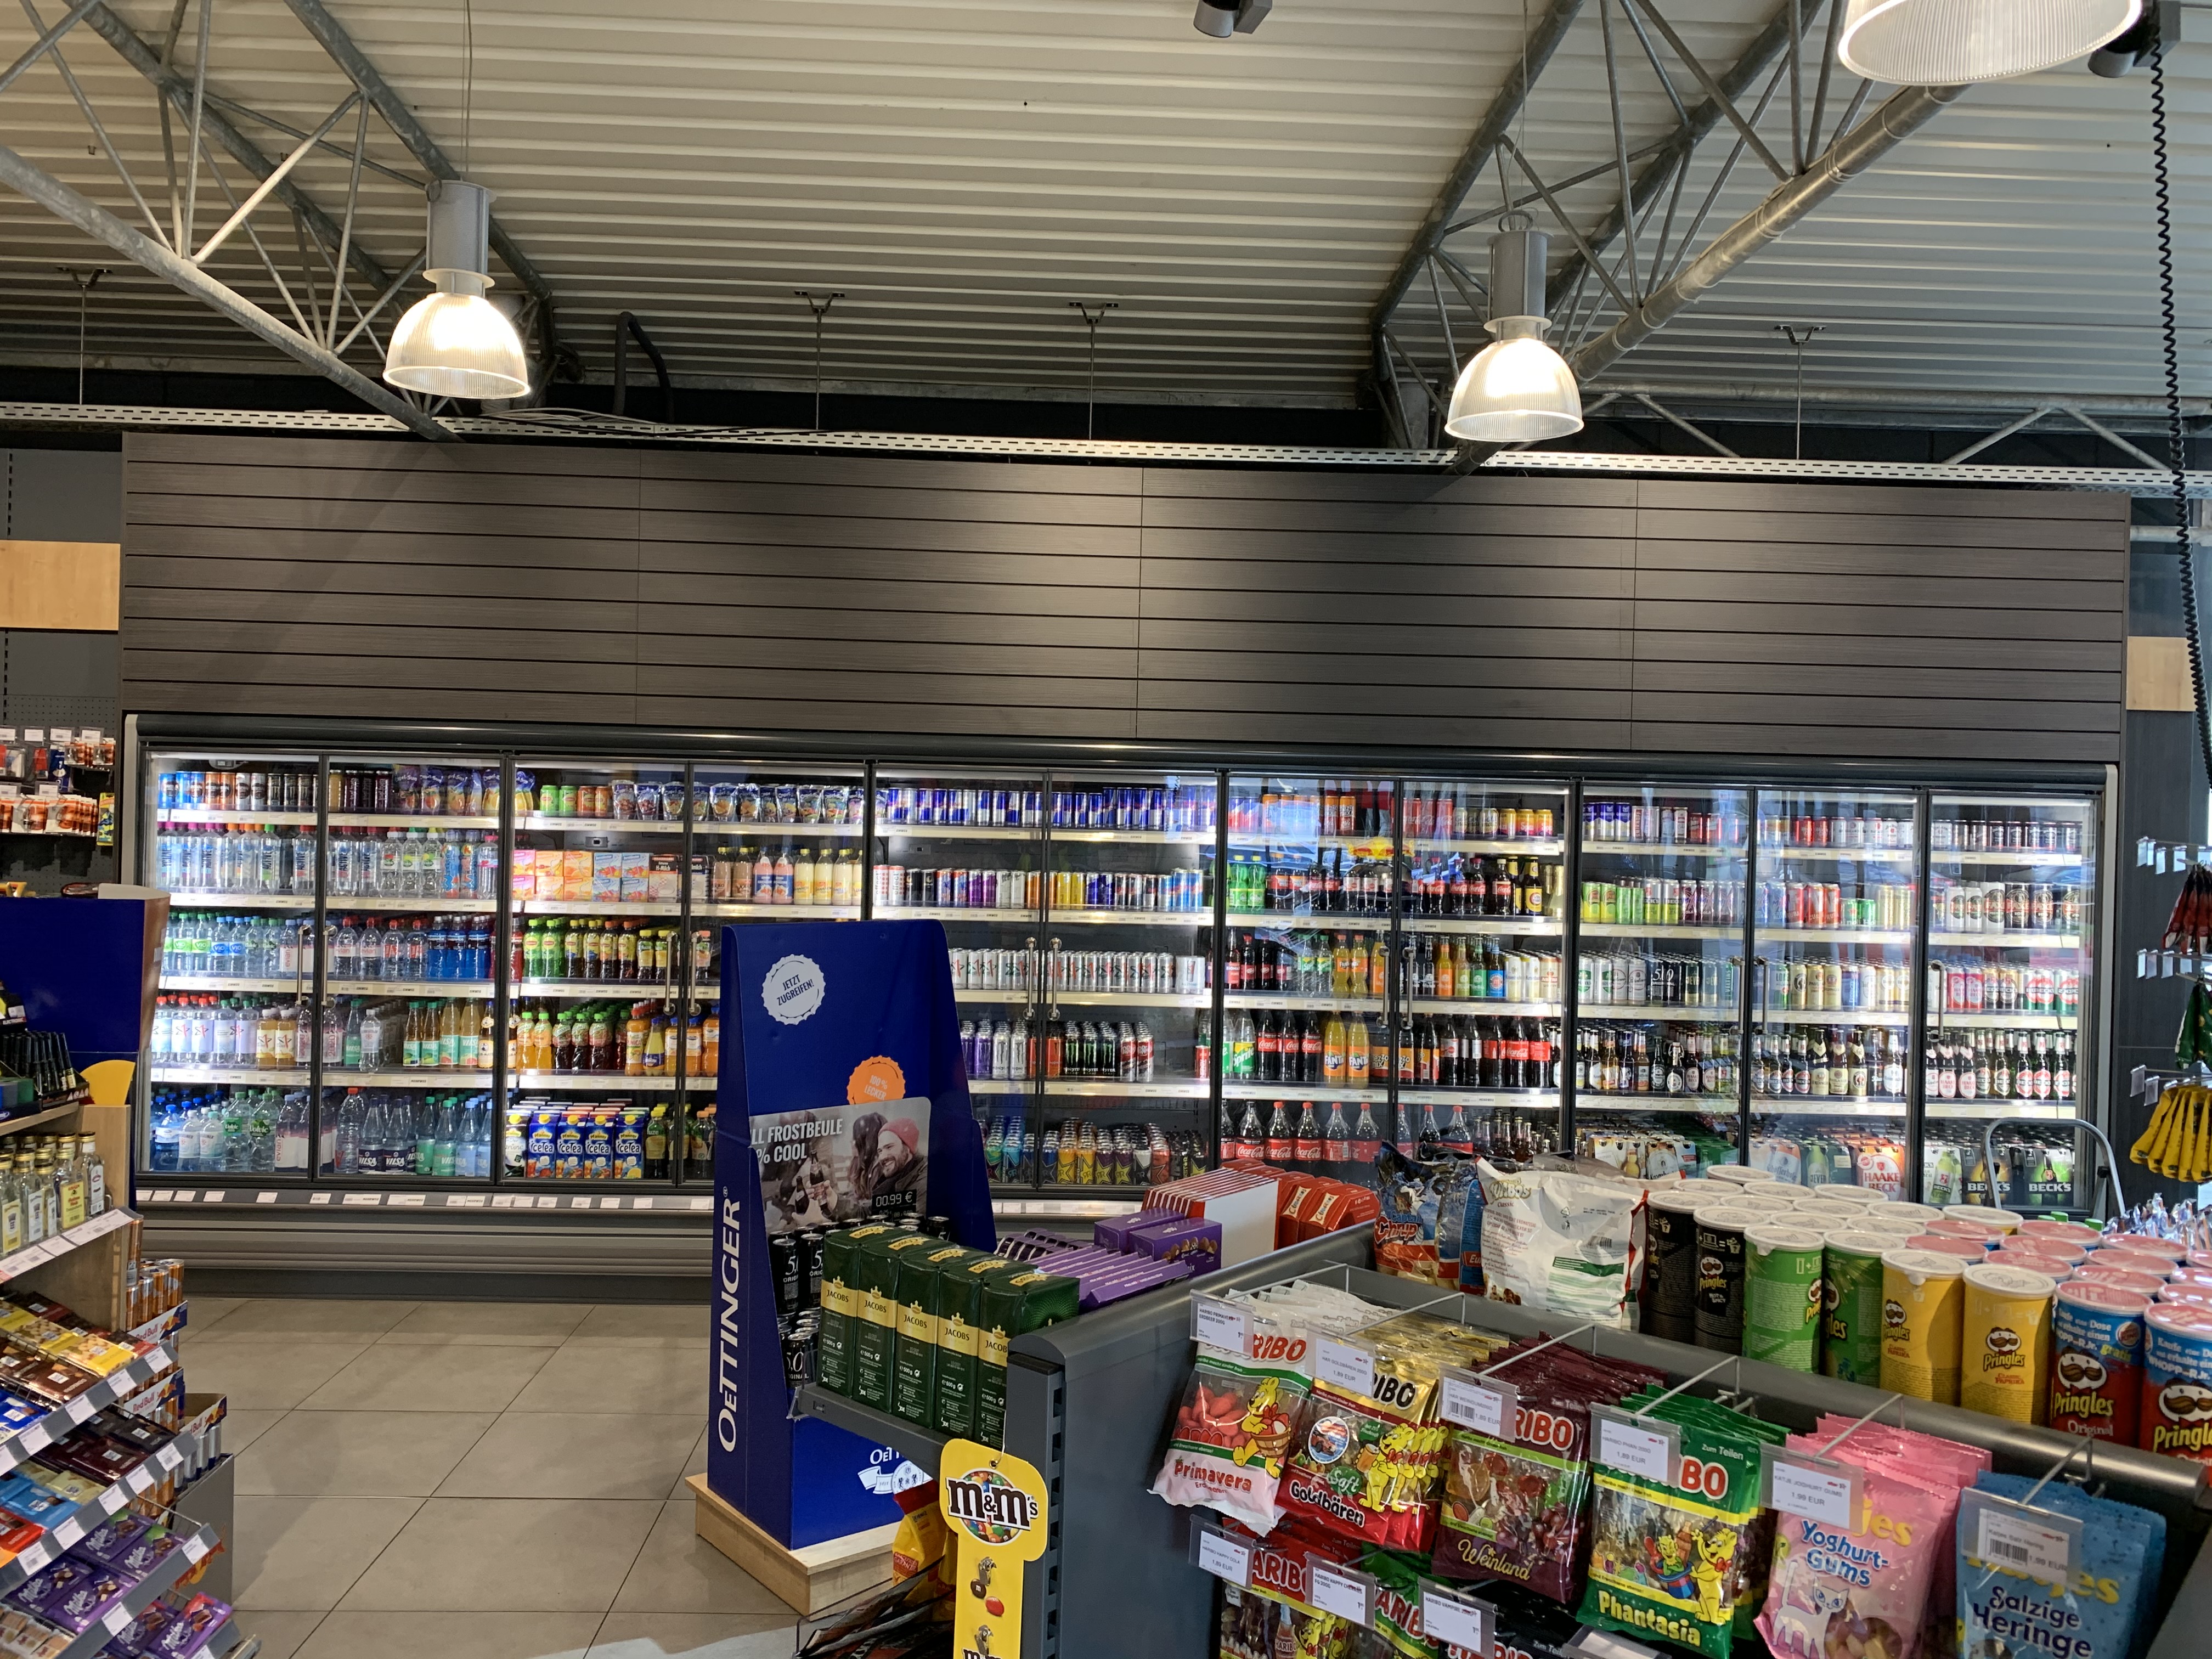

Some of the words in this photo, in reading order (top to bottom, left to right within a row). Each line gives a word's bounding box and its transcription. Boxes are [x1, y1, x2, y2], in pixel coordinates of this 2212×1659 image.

[782, 974, 801, 991] JETZT
[777, 979, 814, 1006] ZUGREIFEN!
[1234, 1047, 1255, 1066] Sprite
[870, 1075, 881, 1086] 100
[864, 1085, 887, 1101] LECKER
[768, 1119, 843, 1143] FROSTBEULE
[774, 1143, 808, 1163] COOL
[1238, 1145, 1263, 1159] Coca-Cola
[1265, 1146, 1291, 1158] Coca-Cola
[1295, 1146, 1321, 1159] Coca-Cola
[386, 1156, 405, 1167] VILSA
[1864, 1173, 1900, 1182] HAAKE
[1868, 1183, 1897, 1193] BECK
[2029, 1182, 2072, 1192] BECK'S
[1700, 1277, 1727, 1291] Pringles
[827, 1290, 849, 1302] JACOBS
[864, 1300, 887, 1313] JACOBS
[147, 1323, 158, 1335] Bull
[904, 1314, 927, 1329] JACOBS
[2090, 1319, 2112, 1331] Dose
[944, 1327, 970, 1341] JACOBS
[2087, 1331, 2111, 1341] einen
[985, 1340, 1007, 1353] JACOB
[1254, 1334, 1307, 1361] RIBO
[2157, 1337, 2182, 1351] Kaufe
[2100, 1344, 2132, 1362] gratis
[2167, 1353, 2198, 1367] erhalte
[1331, 1359, 1357, 1372] GOLDBÄREN
[1983, 1352, 2026, 1372] Pringles
[133, 1402, 144, 1413] Red
[144, 1392, 155, 1404] Bull
[2054, 1391, 2114, 1418] Pringles
[1516, 1408, 1572, 1448] RIBO
[2067, 1420, 2113, 1438] Original
[1632, 1454, 1646, 1464] EUR
[1702, 1443, 1717, 1453] Zum
[1719, 1446, 1743, 1460] Teilen
[1175, 1462, 1252, 1492] Primavera
[1330, 1470, 1359, 1493] Saft
[1793, 1480, 1822, 1492] JOGHURT
[1291, 1480, 1365, 1527] Goldbären
[1808, 1496, 1825, 1506] EUR
[86, 1528, 109, 1550] Milka
[1802, 1520, 1889, 1570] Yoghurt-
[125, 1546, 146, 1569] Milka
[1202, 1545, 1216, 1554] HARIBO
[1217, 1551, 1229, 1559] HAPPY
[1230, 1556, 1240, 1564] COLA
[1458, 1539, 1534, 1581] Weinland
[1806, 1549, 1871, 1587] Gums
[2049, 1561, 2068, 1571] EUR
[1315, 1573, 1330, 1582] HARIBO
[1330, 1578, 1343, 1587] HAPPY
[18, 1578, 43, 1602] Milka
[64, 1590, 88, 1615] Milka
[1425, 1597, 1442, 1606] HARIBO
[1442, 1602, 1461, 1613] VAMPIRE
[1989, 1585, 2081, 1629] Salzige
[1598, 1590, 1701, 1647] Phantasia
[117, 1621, 137, 1645] Milka
[161, 1621, 184, 1650] Milka
[1973, 1602, 2092, 1659] Heringe
